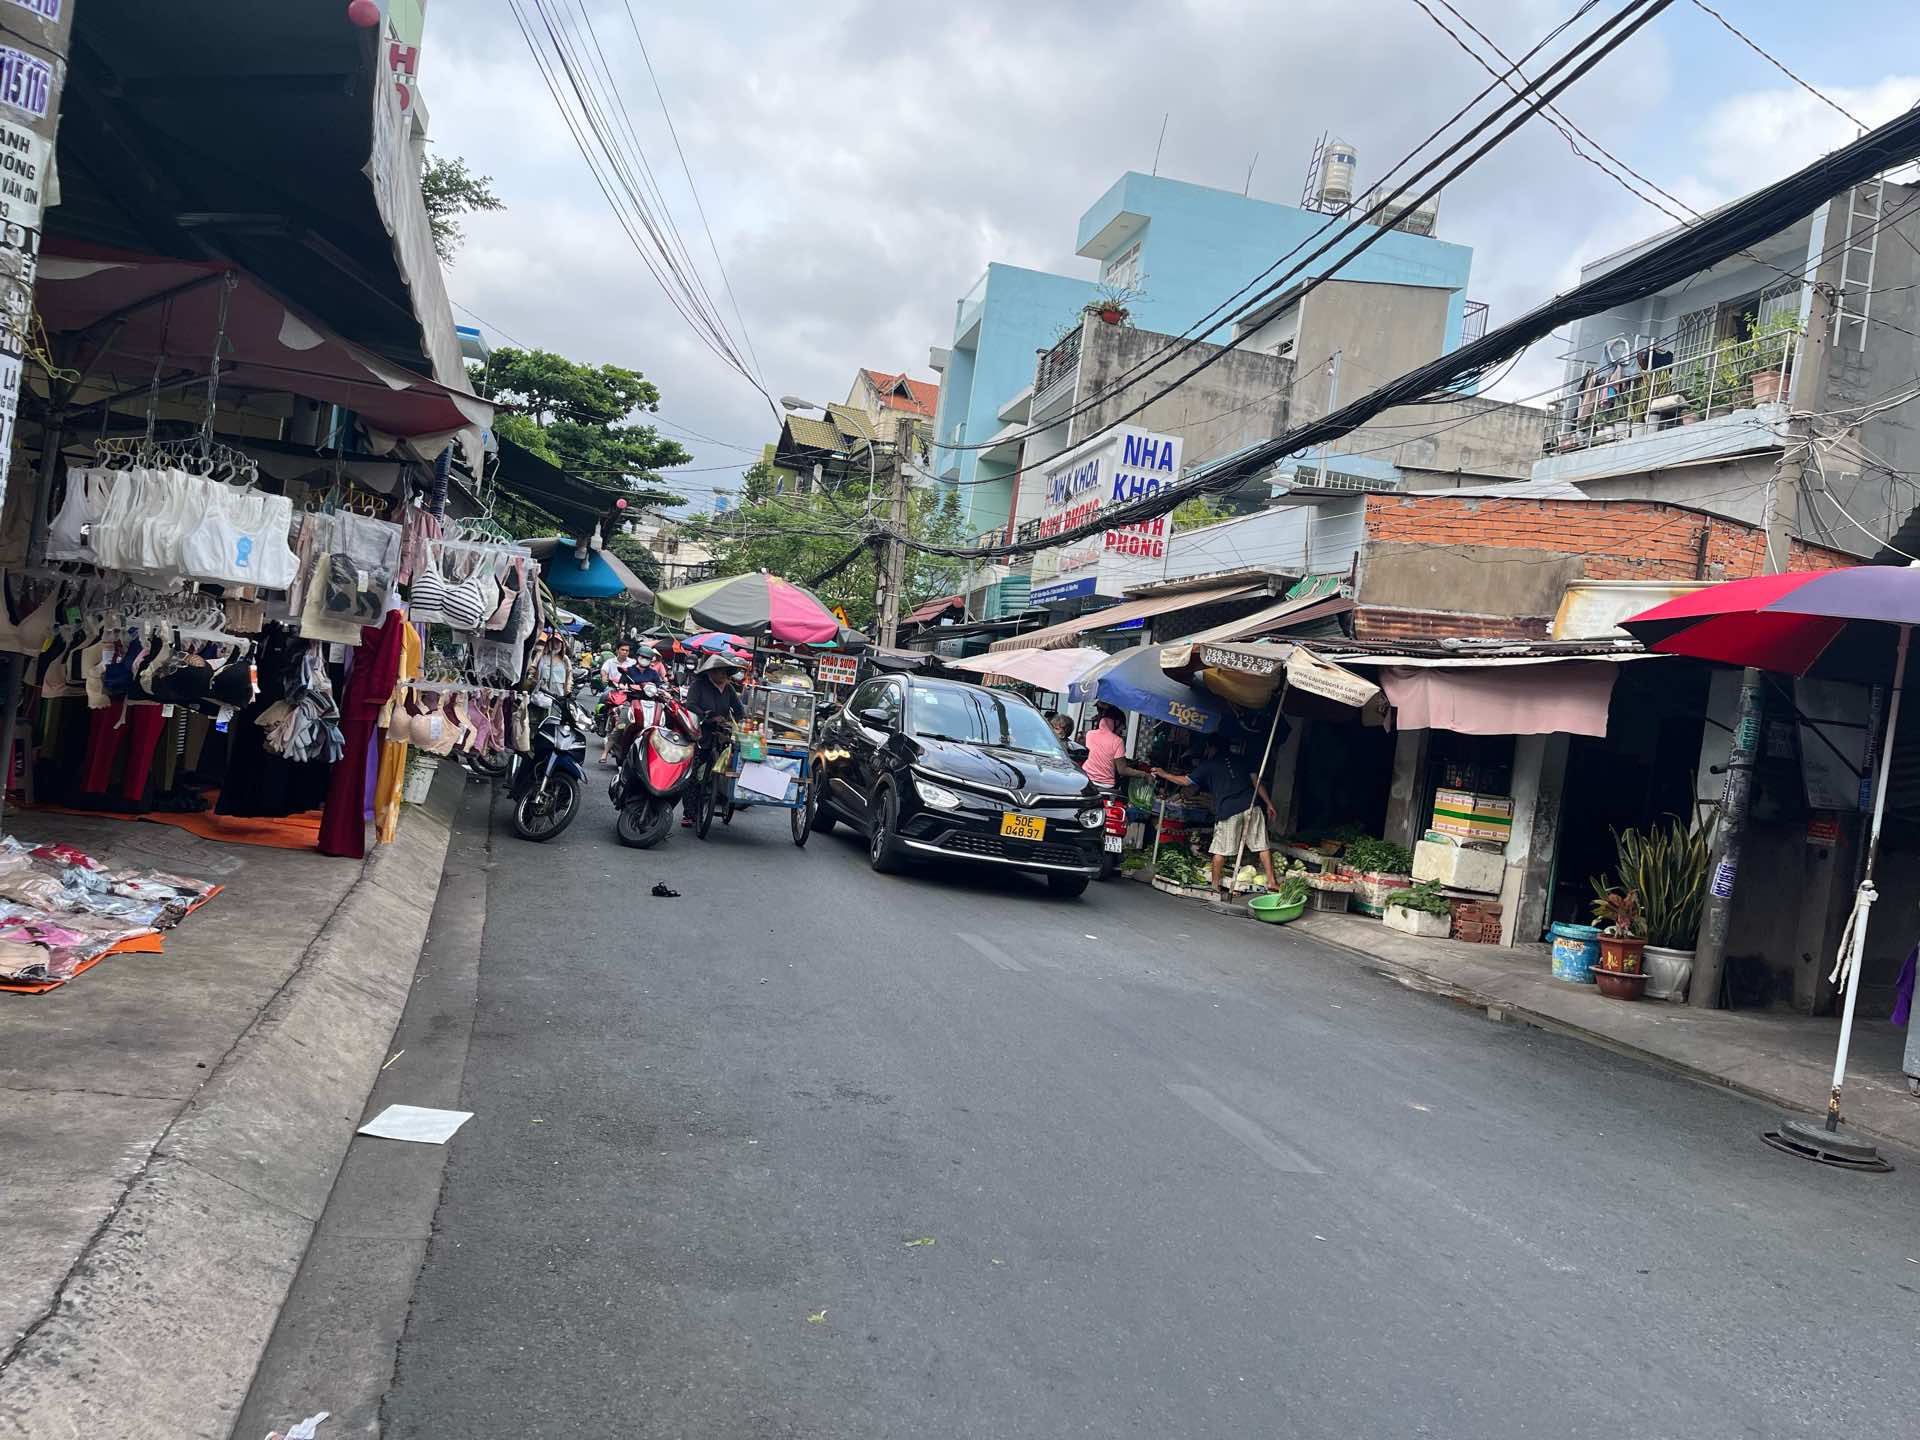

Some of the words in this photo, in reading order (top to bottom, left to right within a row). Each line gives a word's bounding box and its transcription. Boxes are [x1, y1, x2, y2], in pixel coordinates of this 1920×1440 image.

[1123, 434, 1173, 472] NHA
[1072, 459, 1099, 496] KHOA
[1105, 531, 1164, 558] PHONG
[1168, 700, 1209, 727] Tiger
[1005, 825, 1040, 838] 048.97
[1015, 815, 1034, 827] 50E
